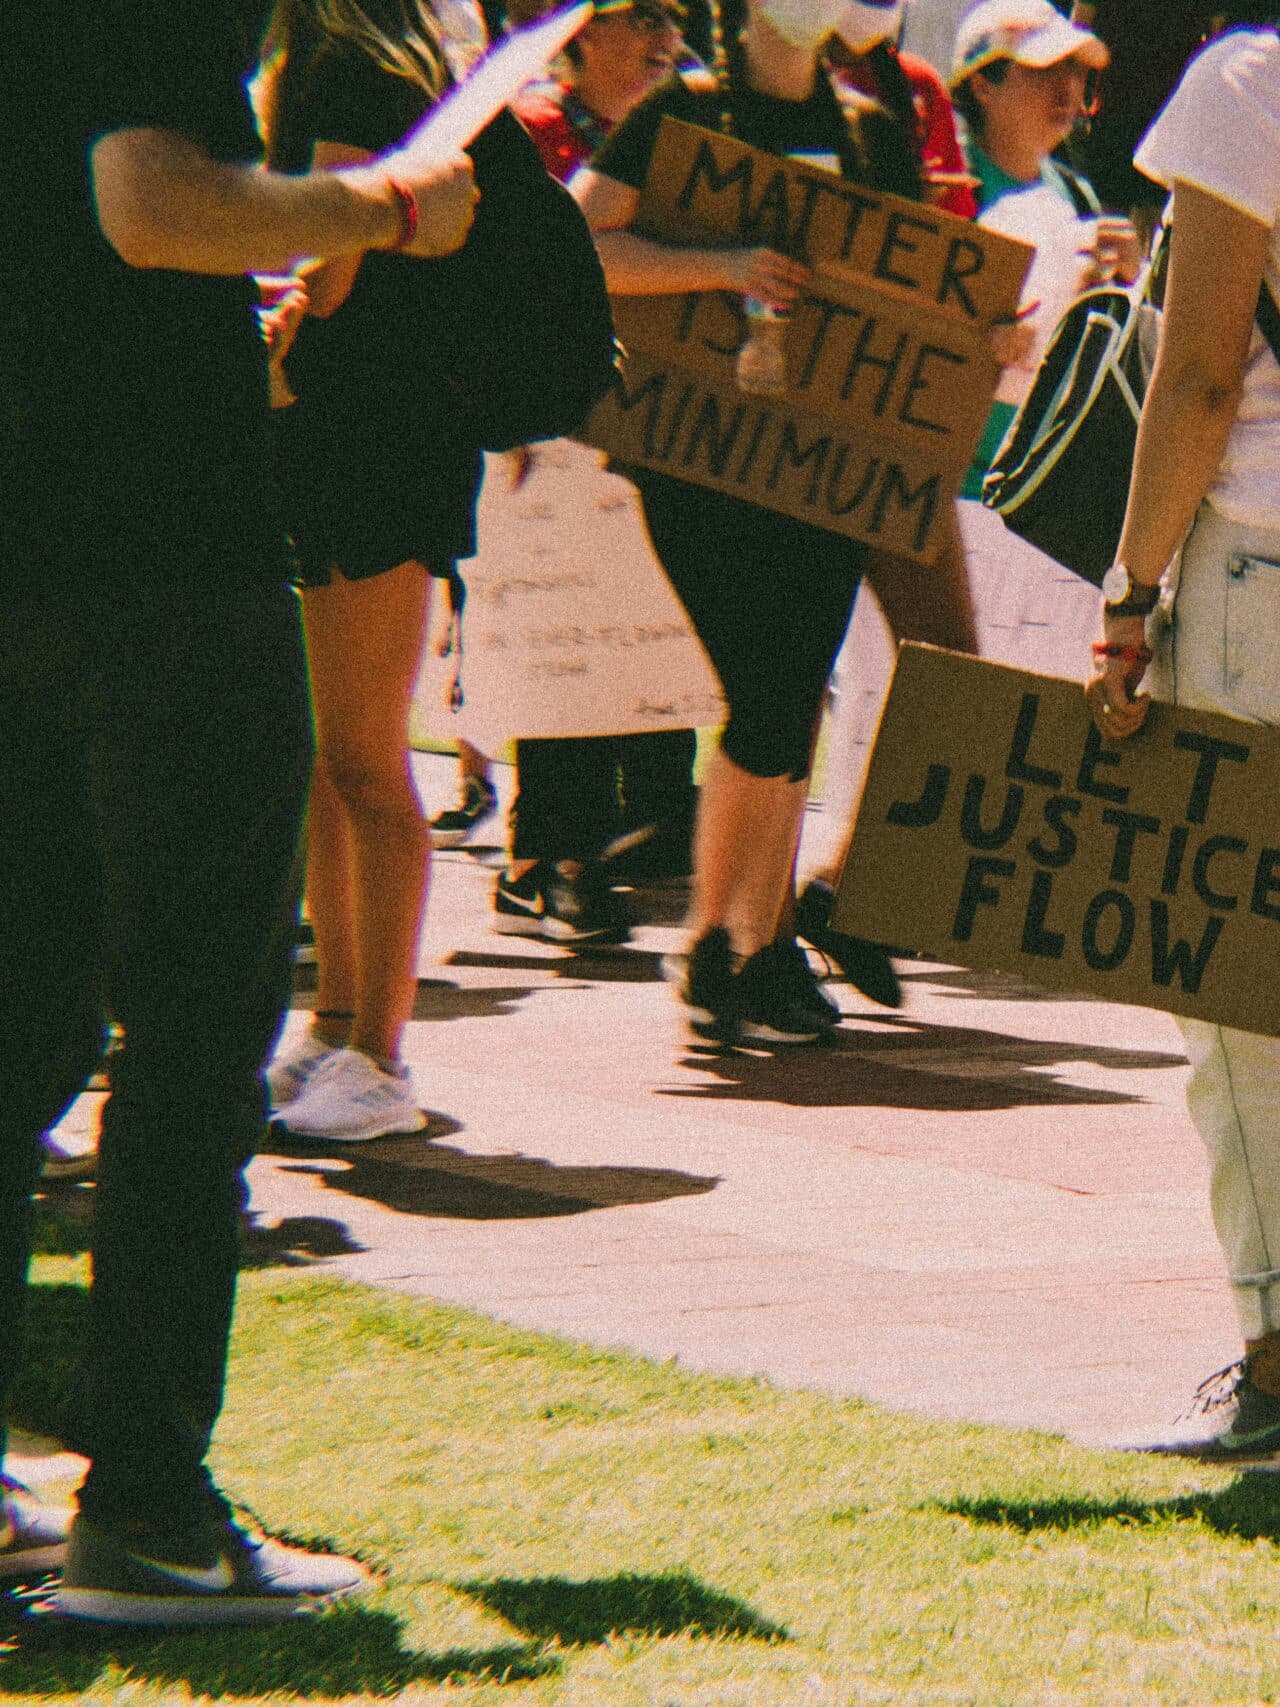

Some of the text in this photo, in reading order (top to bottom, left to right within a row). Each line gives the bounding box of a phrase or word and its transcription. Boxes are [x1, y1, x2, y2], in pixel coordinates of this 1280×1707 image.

[676, 139, 986, 318] MATTER
[797, 296, 968, 435] THE
[610, 372, 943, 553] MINIMUM
[1005, 693, 1251, 825] LET
[952, 855, 1226, 995] FLOW
